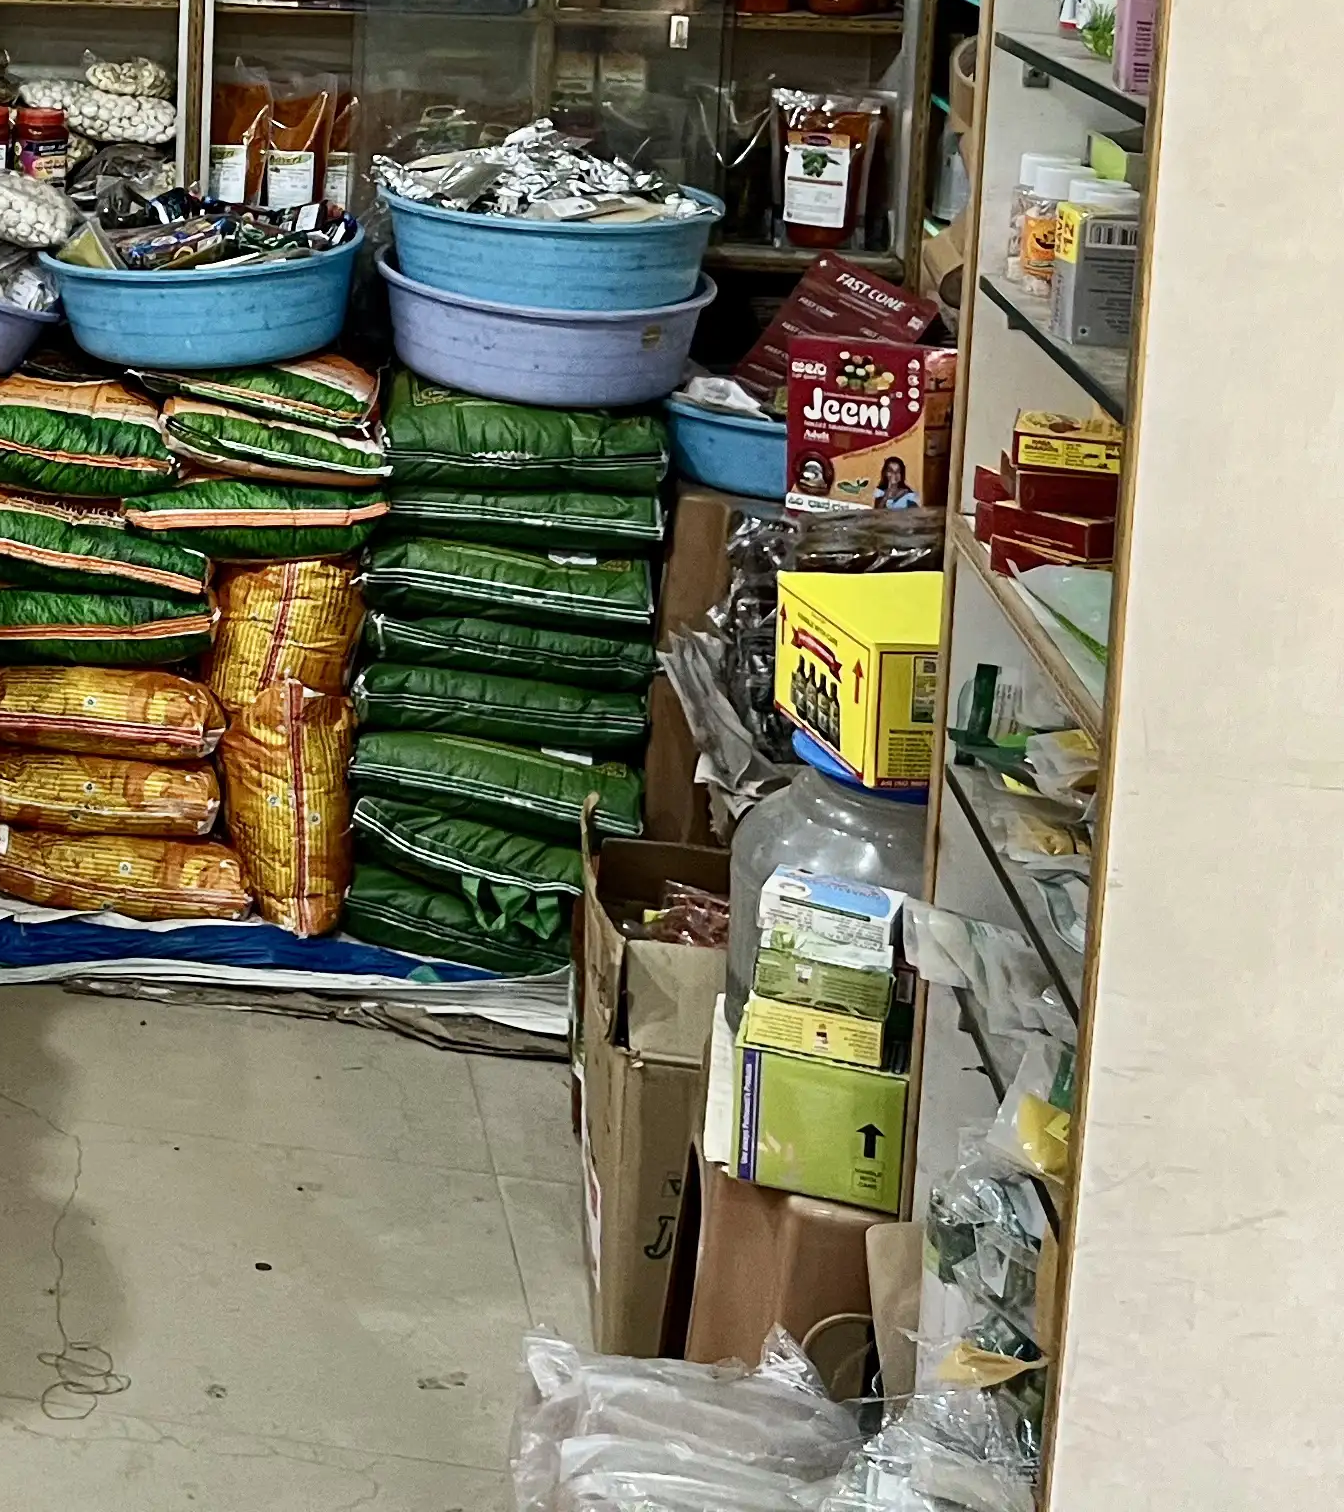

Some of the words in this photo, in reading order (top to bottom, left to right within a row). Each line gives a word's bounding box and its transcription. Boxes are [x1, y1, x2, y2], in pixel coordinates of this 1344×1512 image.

[836, 273, 871, 294] FAST
[868, 287, 907, 312] CONE
[804, 388, 890, 429] Jeeni
